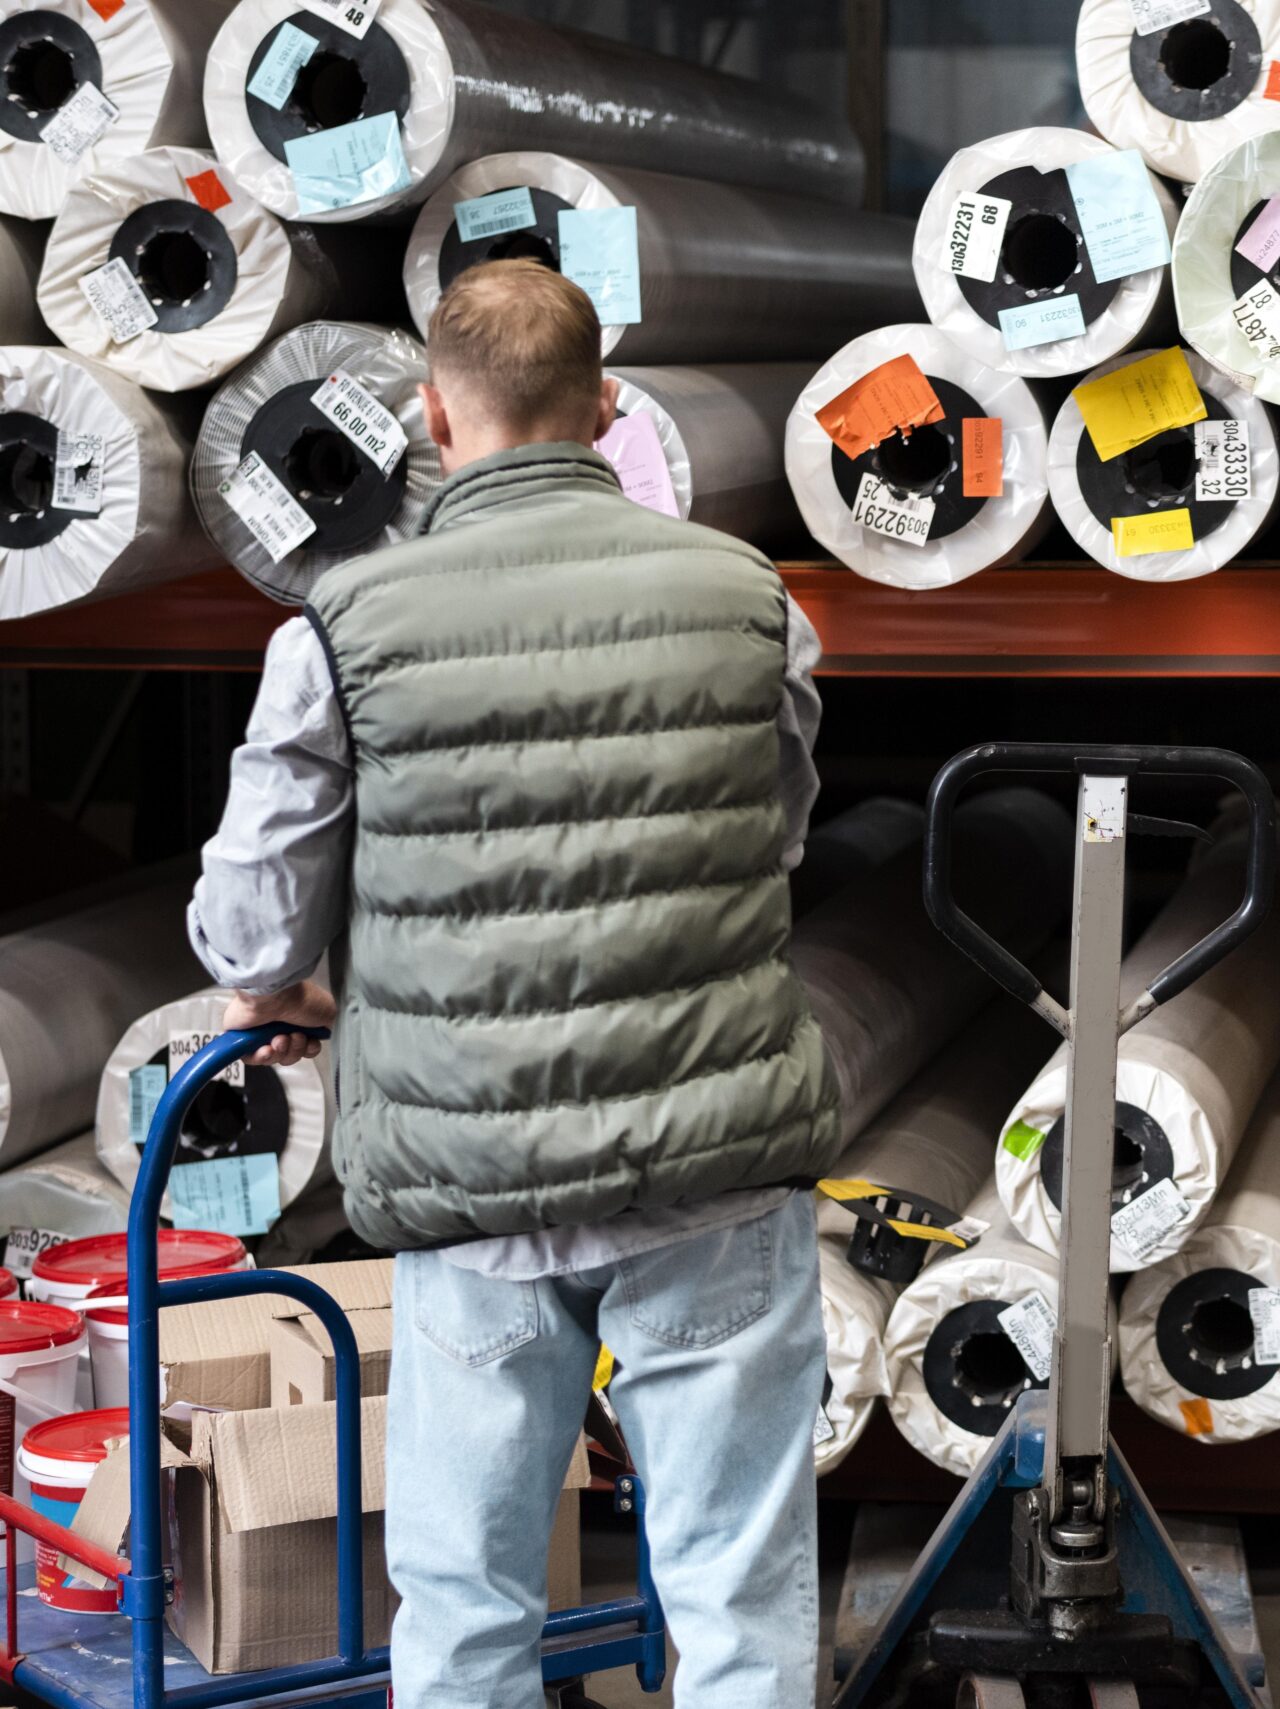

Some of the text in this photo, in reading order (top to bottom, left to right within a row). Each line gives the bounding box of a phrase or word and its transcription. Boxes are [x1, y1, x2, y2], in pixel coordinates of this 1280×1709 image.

[343, 6, 365, 27] 48
[981, 204, 998, 225] 68
[946, 201, 975, 272] 13032231
[1248, 286, 1272, 310] 87
[344, 385, 371, 412] AVENUE
[331, 400, 387, 456] 66,00 m2
[1223, 420, 1247, 497] 30433330
[861, 479, 881, 500] 25
[1201, 479, 1220, 495] 32
[853, 500, 929, 543] 30392291
[170, 1033, 219, 1055] 30436
[1111, 1187, 1167, 1231] 30-713Mn
[7, 1227, 69, 1255] 303926
[1007, 1318, 1049, 1377] 30-448Mn
